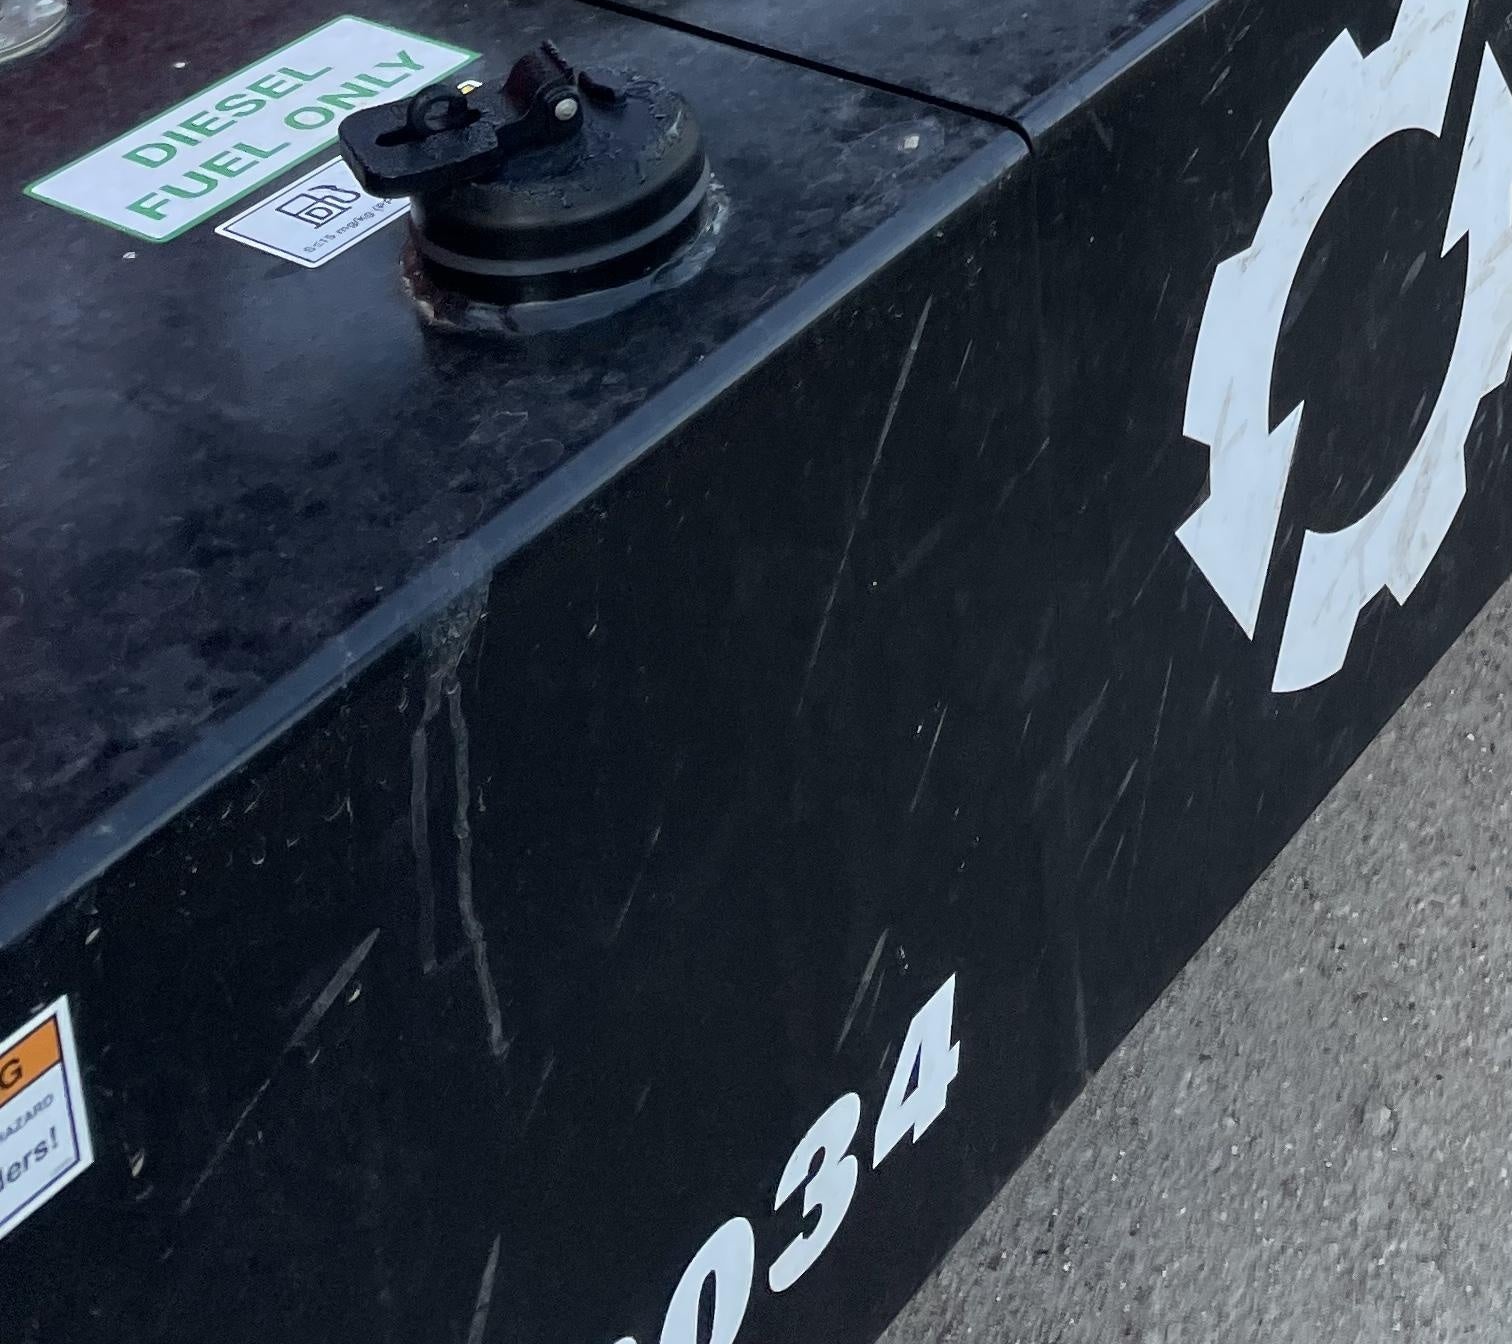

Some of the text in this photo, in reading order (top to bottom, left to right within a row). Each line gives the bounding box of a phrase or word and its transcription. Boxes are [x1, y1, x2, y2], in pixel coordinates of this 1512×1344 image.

[121, 66, 334, 169] DIESEL
[125, 49, 425, 221] FUEL ONLY
[612, 972, 960, 1344] 034
